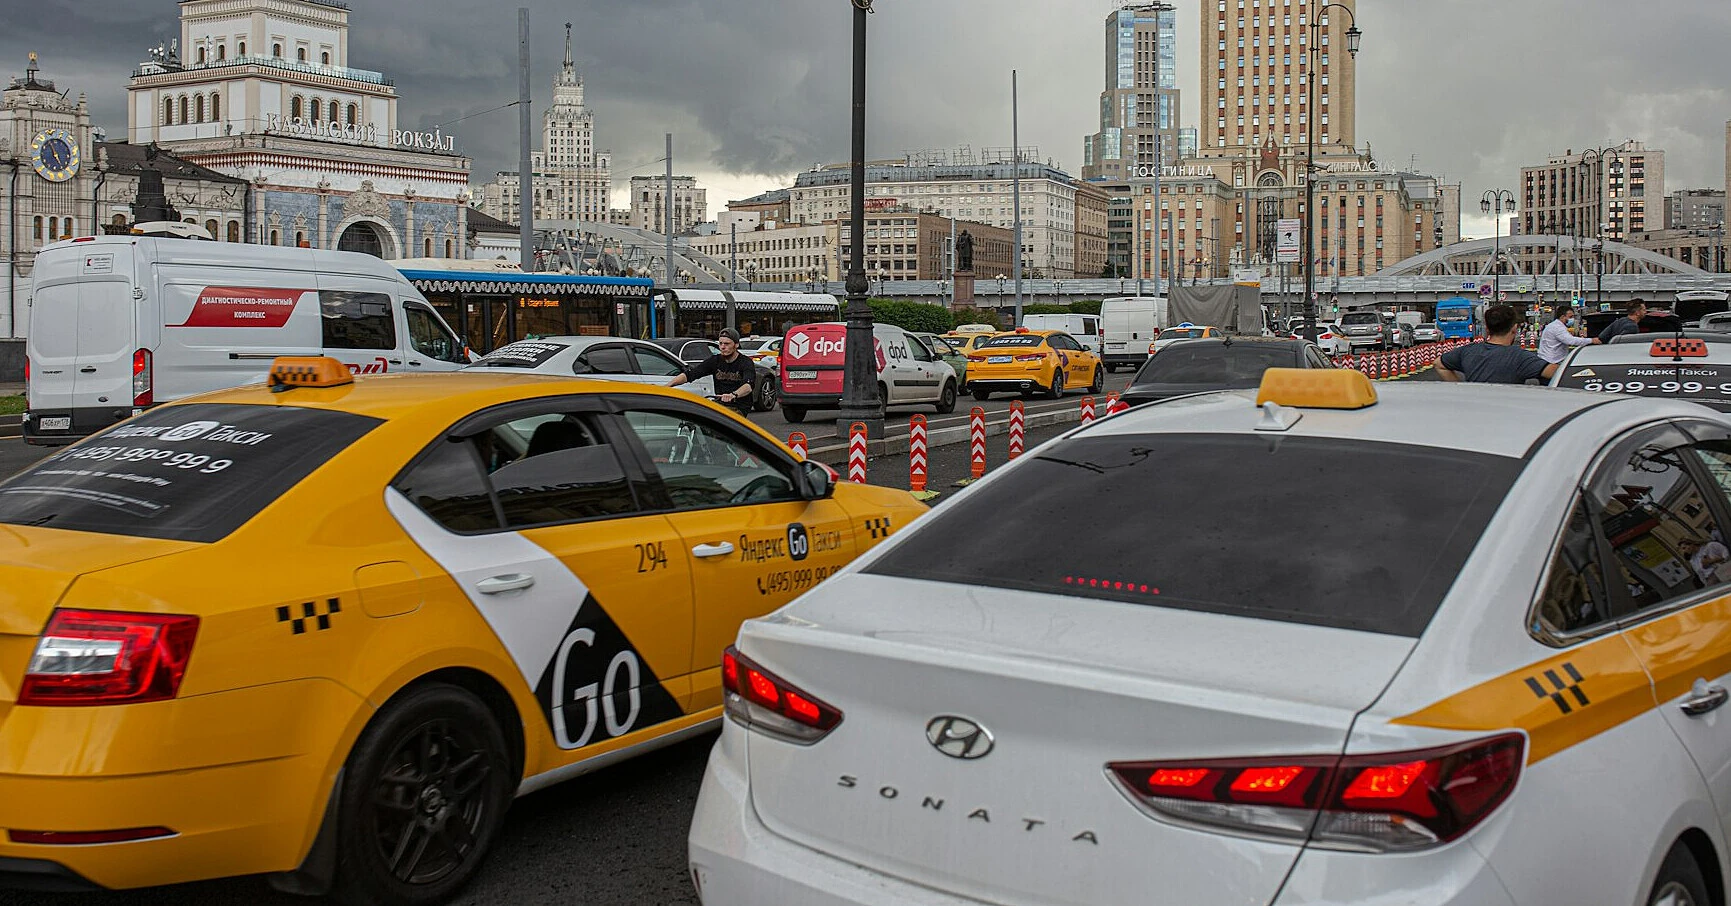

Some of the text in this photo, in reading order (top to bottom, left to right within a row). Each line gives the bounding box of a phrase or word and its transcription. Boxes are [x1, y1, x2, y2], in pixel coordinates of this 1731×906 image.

[267, 112, 454, 151] КАЗАНСКИЙ ВОКЗАЛ
[1133, 165, 1213, 177] ГОСТИНИЦА
[201, 296, 293, 306] ДИАГНОСТИЧЕСКО-РЕМОНТНЫЙ
[234, 311, 266, 319] КОМПЛЕКС
[813, 336, 845, 356] dpd
[888, 340, 908, 362] dpd
[1627, 368, 1718, 377] Яндекс Такси
[202, 425, 273, 446] Такси
[162, 452, 211, 469] 99
[199, 458, 234, 474] 9
[739, 526, 842, 563] Яндекс Go Такси
[634, 541, 667, 574] 294
[766, 571, 793, 596] (495)
[794, 568, 812, 589] 999
[550, 627, 641, 750] Go
[837, 775, 1100, 845] SONATA
